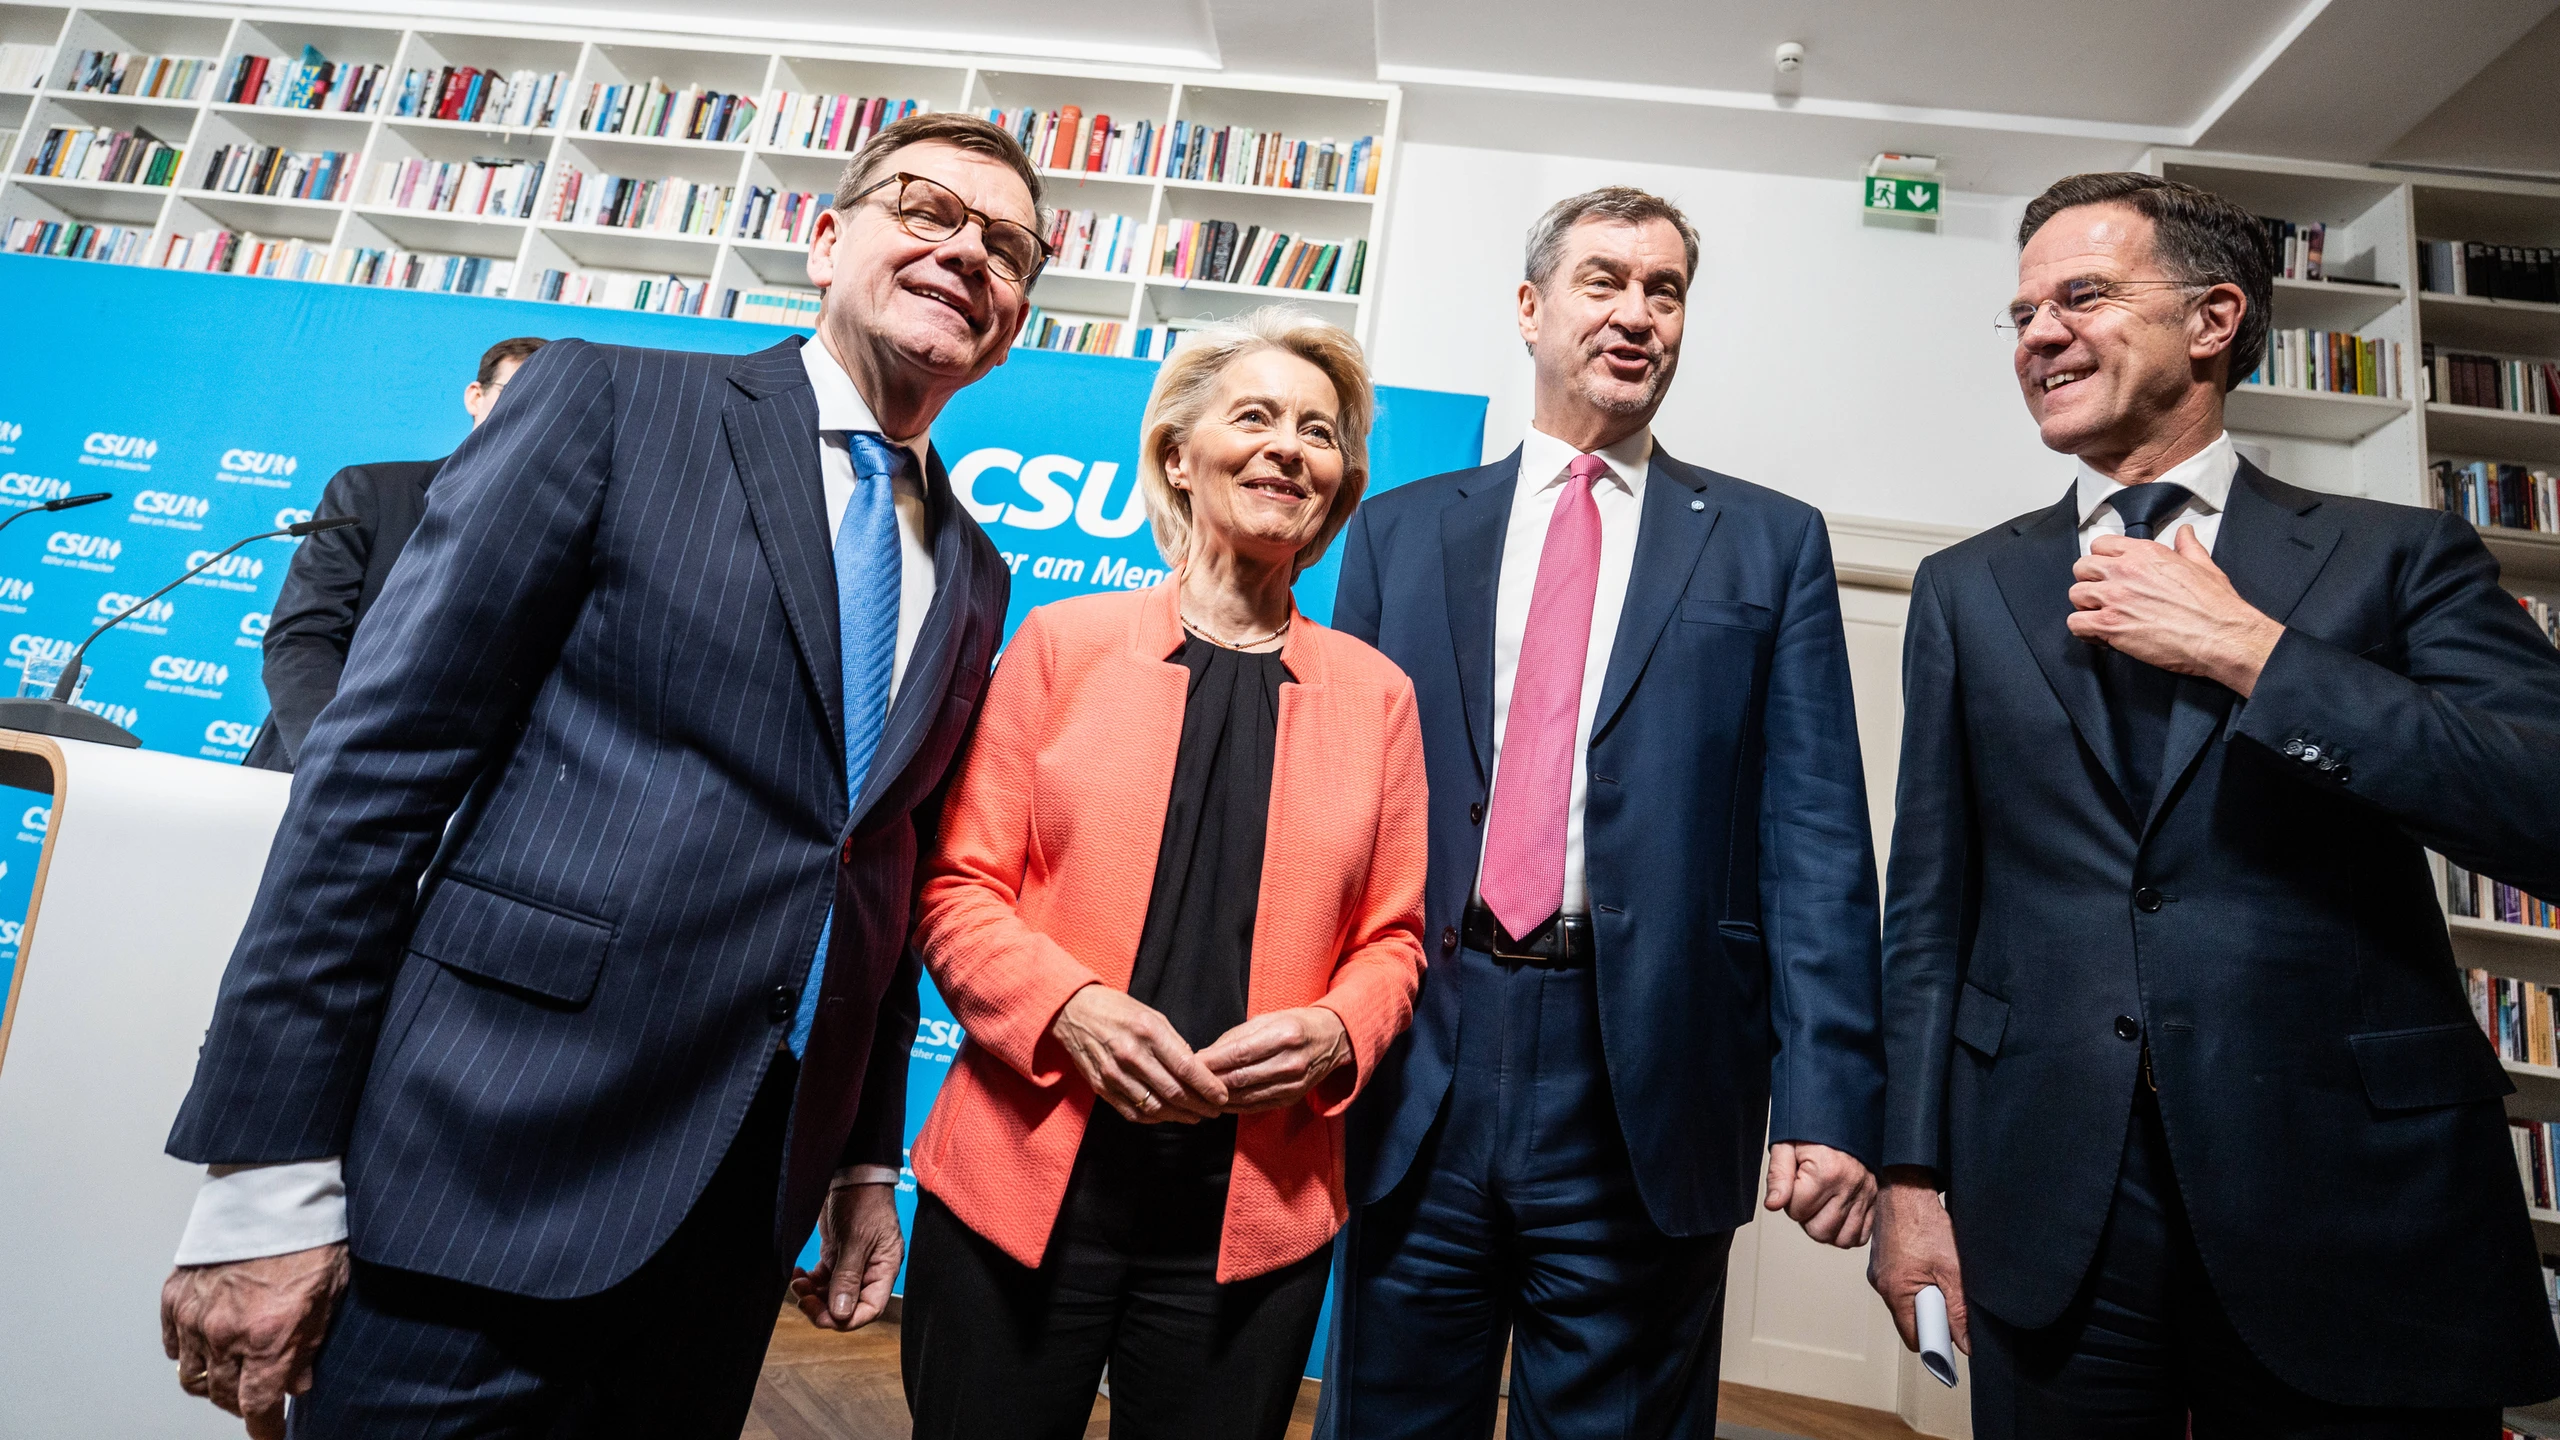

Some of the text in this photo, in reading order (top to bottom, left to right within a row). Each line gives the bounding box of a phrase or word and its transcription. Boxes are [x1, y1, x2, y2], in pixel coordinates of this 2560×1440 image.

[83, 432, 137, 457] CSU
[220, 448, 276, 474] CSU
[0, 472, 52, 498] CSU
[949, 447, 1147, 539] CSU
[133, 490, 188, 516] CSU
[46, 531, 101, 557] CSU
[185, 550, 242, 576] CSU
[1032, 555, 1085, 582] am
[97, 592, 152, 619] CSU
[9, 633, 64, 660] CSU
[149, 655, 207, 682] CSU
[205, 719, 261, 749] CSU
